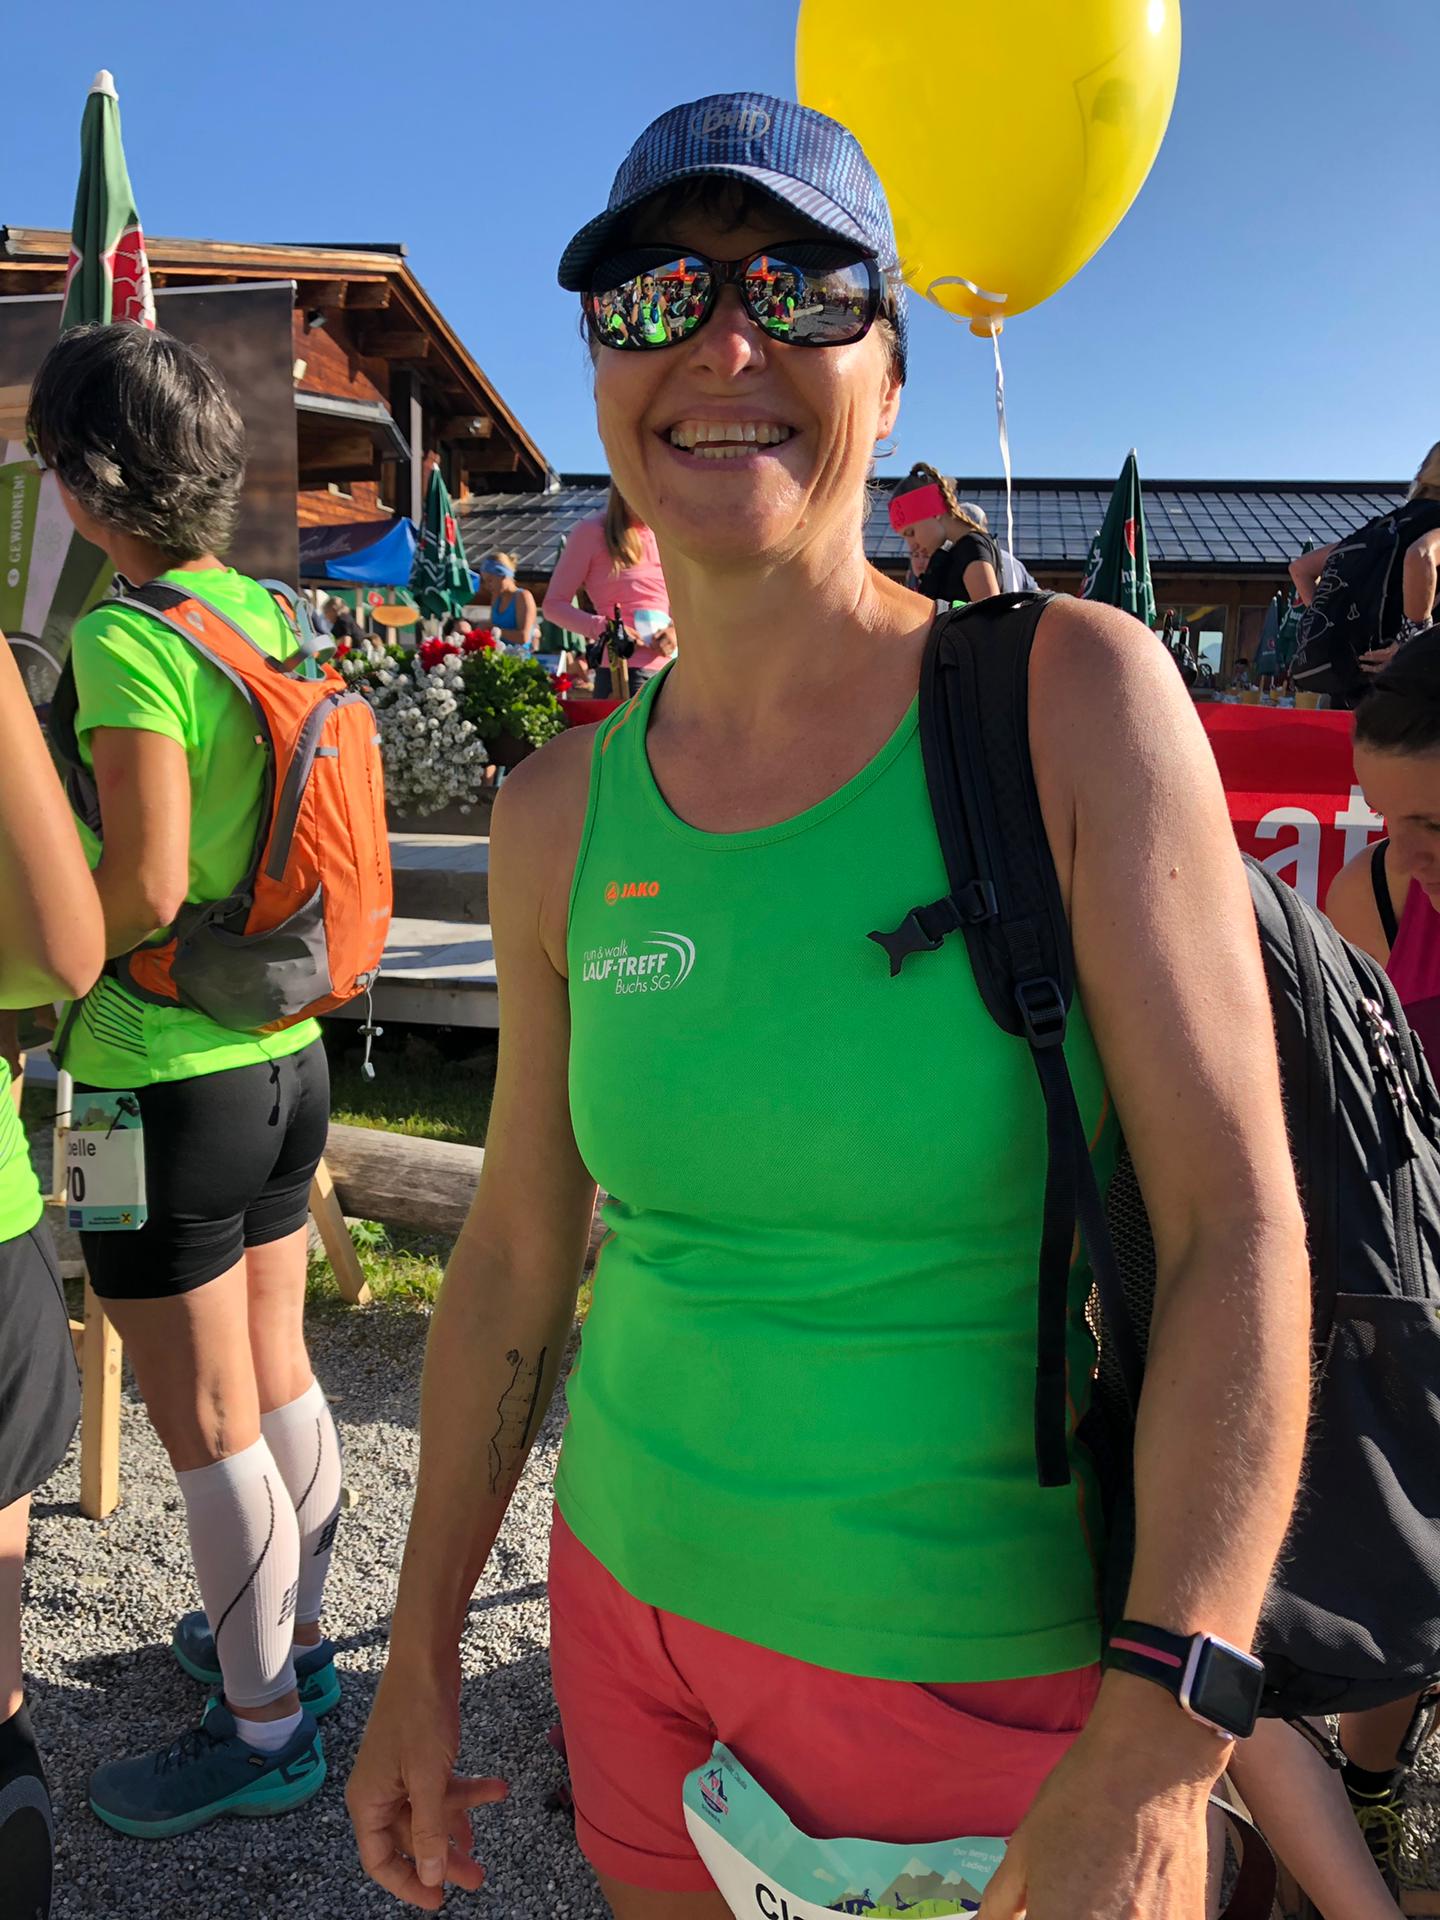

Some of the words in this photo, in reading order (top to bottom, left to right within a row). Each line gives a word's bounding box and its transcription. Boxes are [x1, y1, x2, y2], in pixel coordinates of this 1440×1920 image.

[9, 475, 25, 562] GEWONNEN!
[621, 881, 660, 898] JAKO
[583, 953, 669, 982] LAUF-TREFF
[615, 976, 648, 994] Buchs
[649, 973, 671, 991] SG
[67, 1138, 97, 1157] elle
[755, 1882, 806, 1920] Cl
